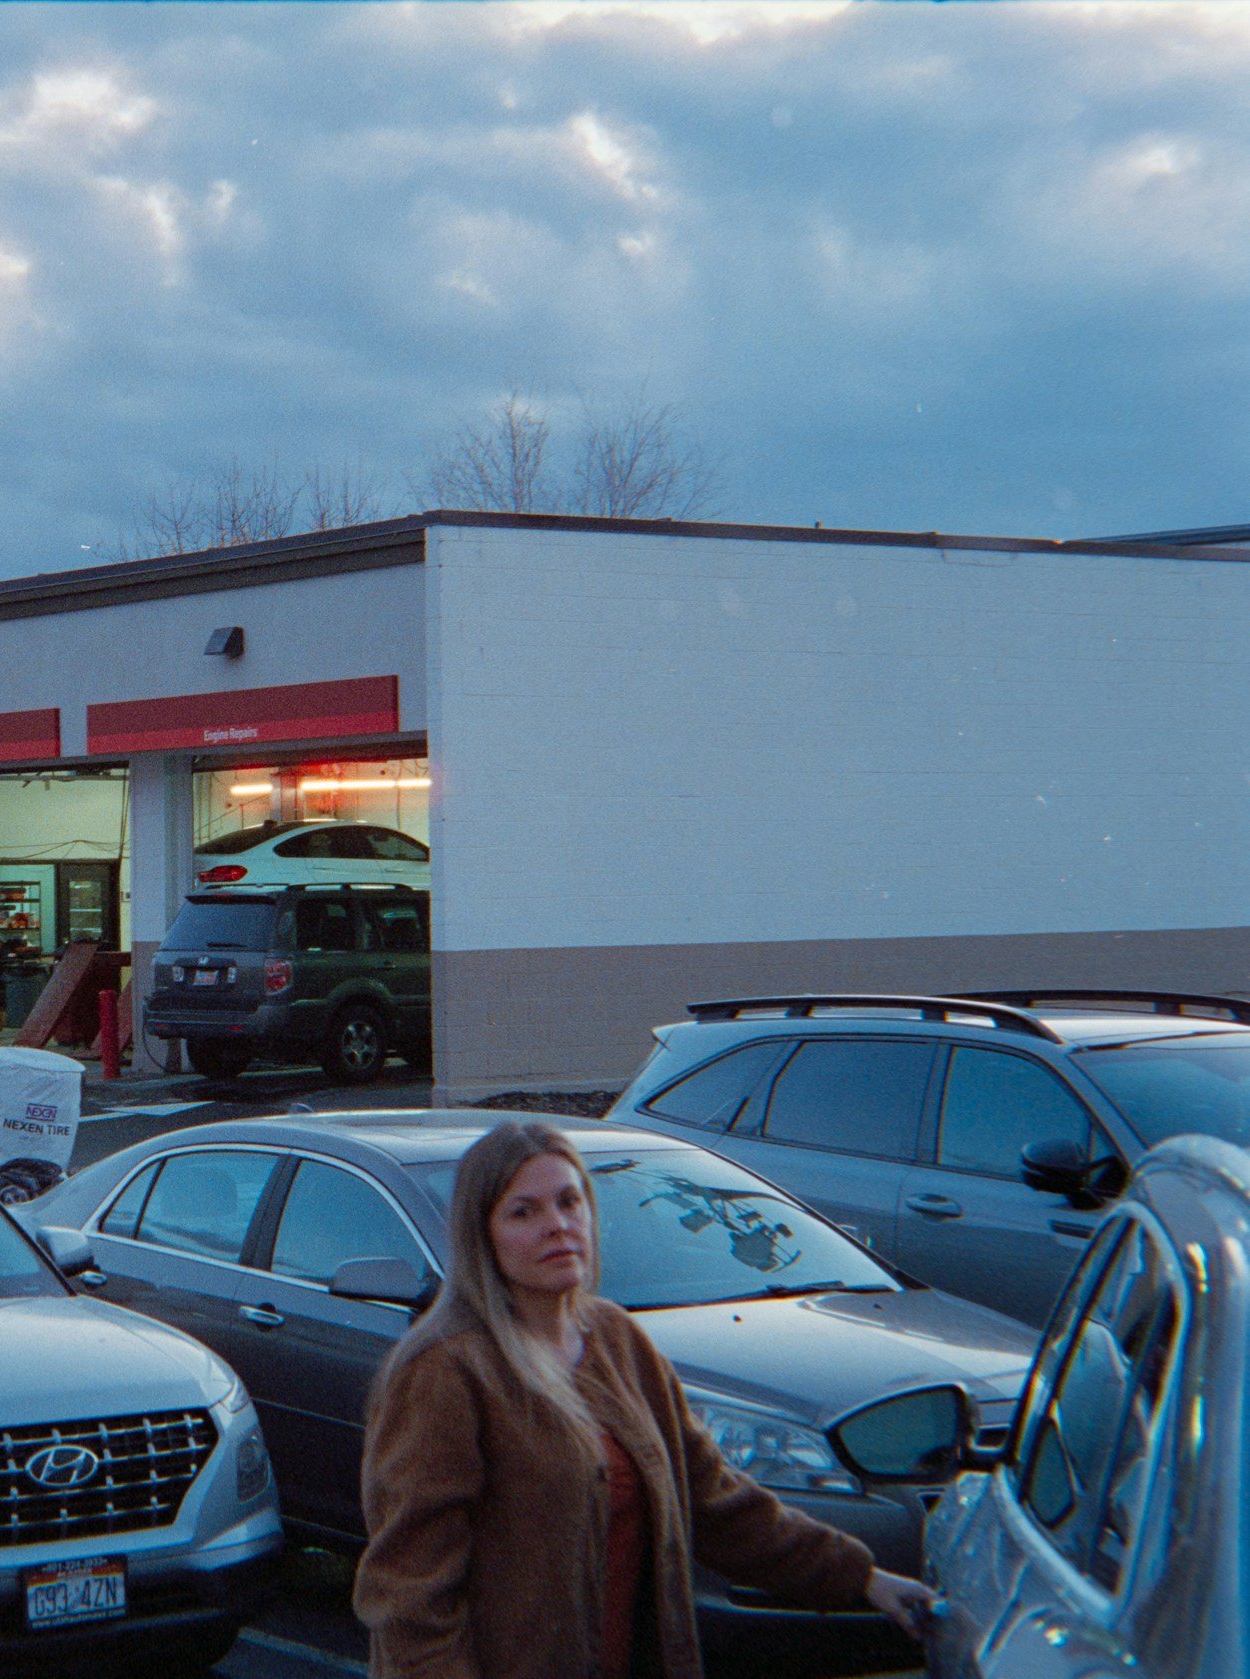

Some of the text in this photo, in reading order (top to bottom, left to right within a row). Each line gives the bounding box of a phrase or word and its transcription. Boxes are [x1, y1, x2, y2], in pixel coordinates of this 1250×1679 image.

[203, 726, 258, 743] Engine Repairs
[2, 1118, 70, 1136] NEXEN TIRE
